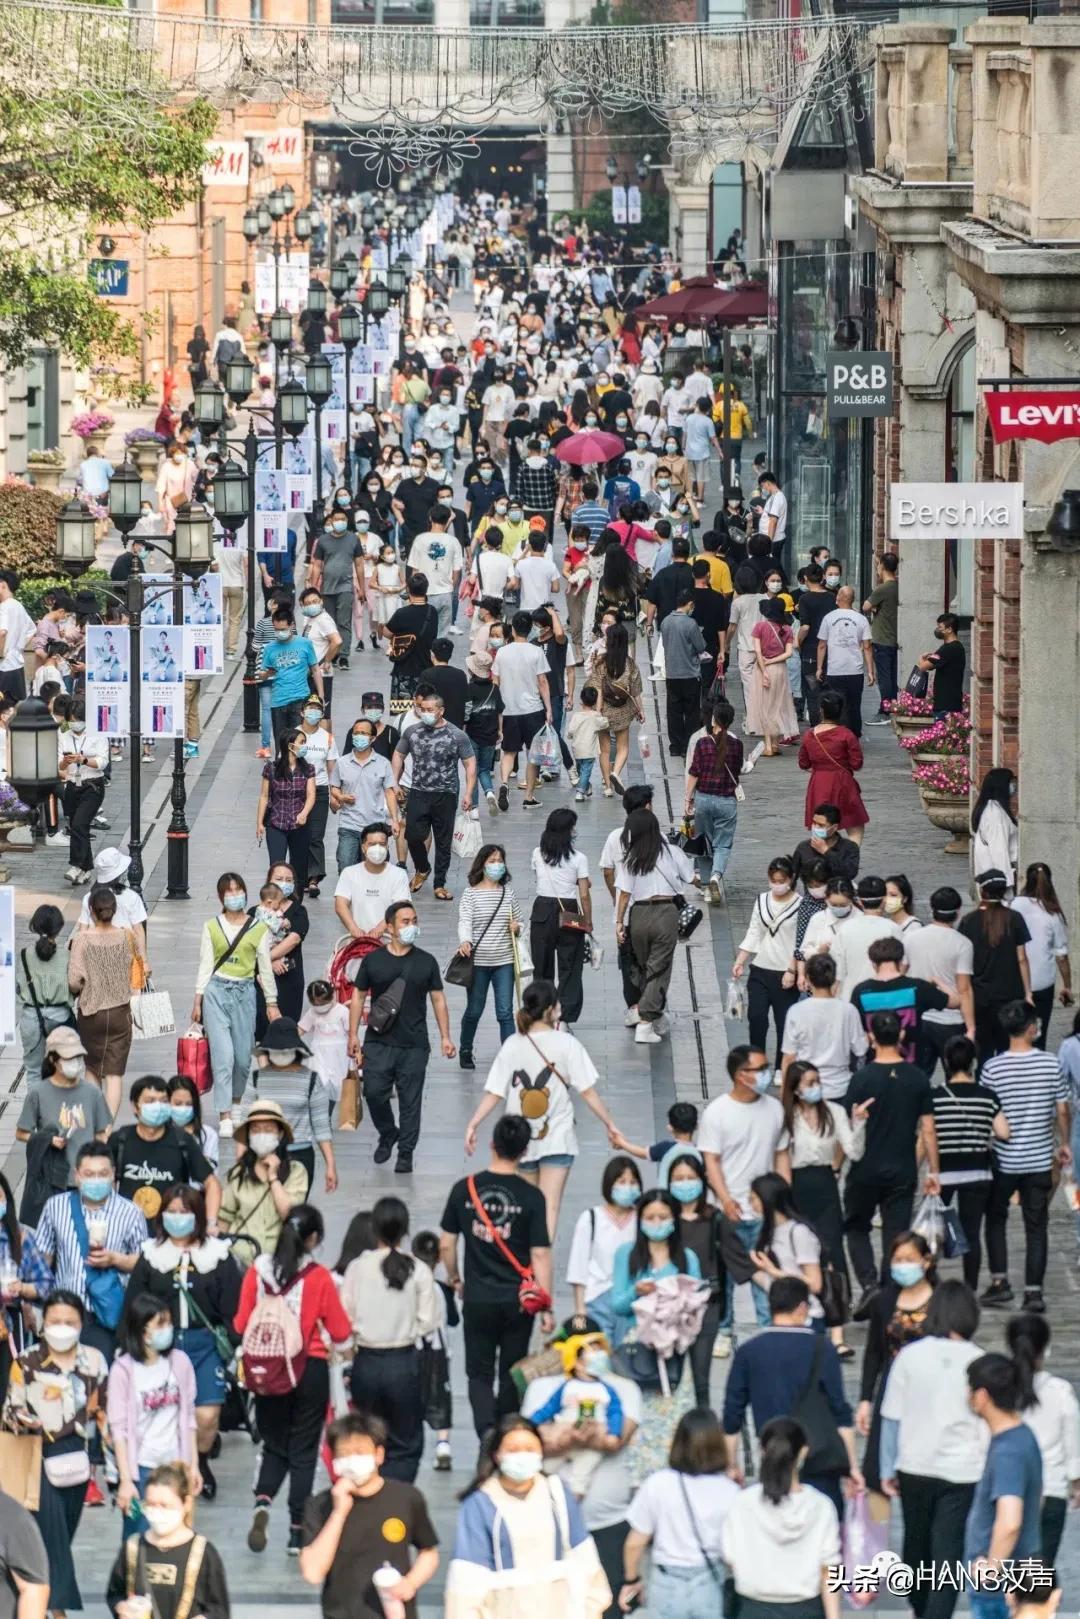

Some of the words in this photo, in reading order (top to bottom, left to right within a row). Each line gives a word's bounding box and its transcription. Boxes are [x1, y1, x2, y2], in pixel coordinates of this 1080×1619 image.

[833, 364, 887, 390] P&B
[833, 395, 886, 405] PULL&BEAR
[898, 498, 1010, 527] Bershka
